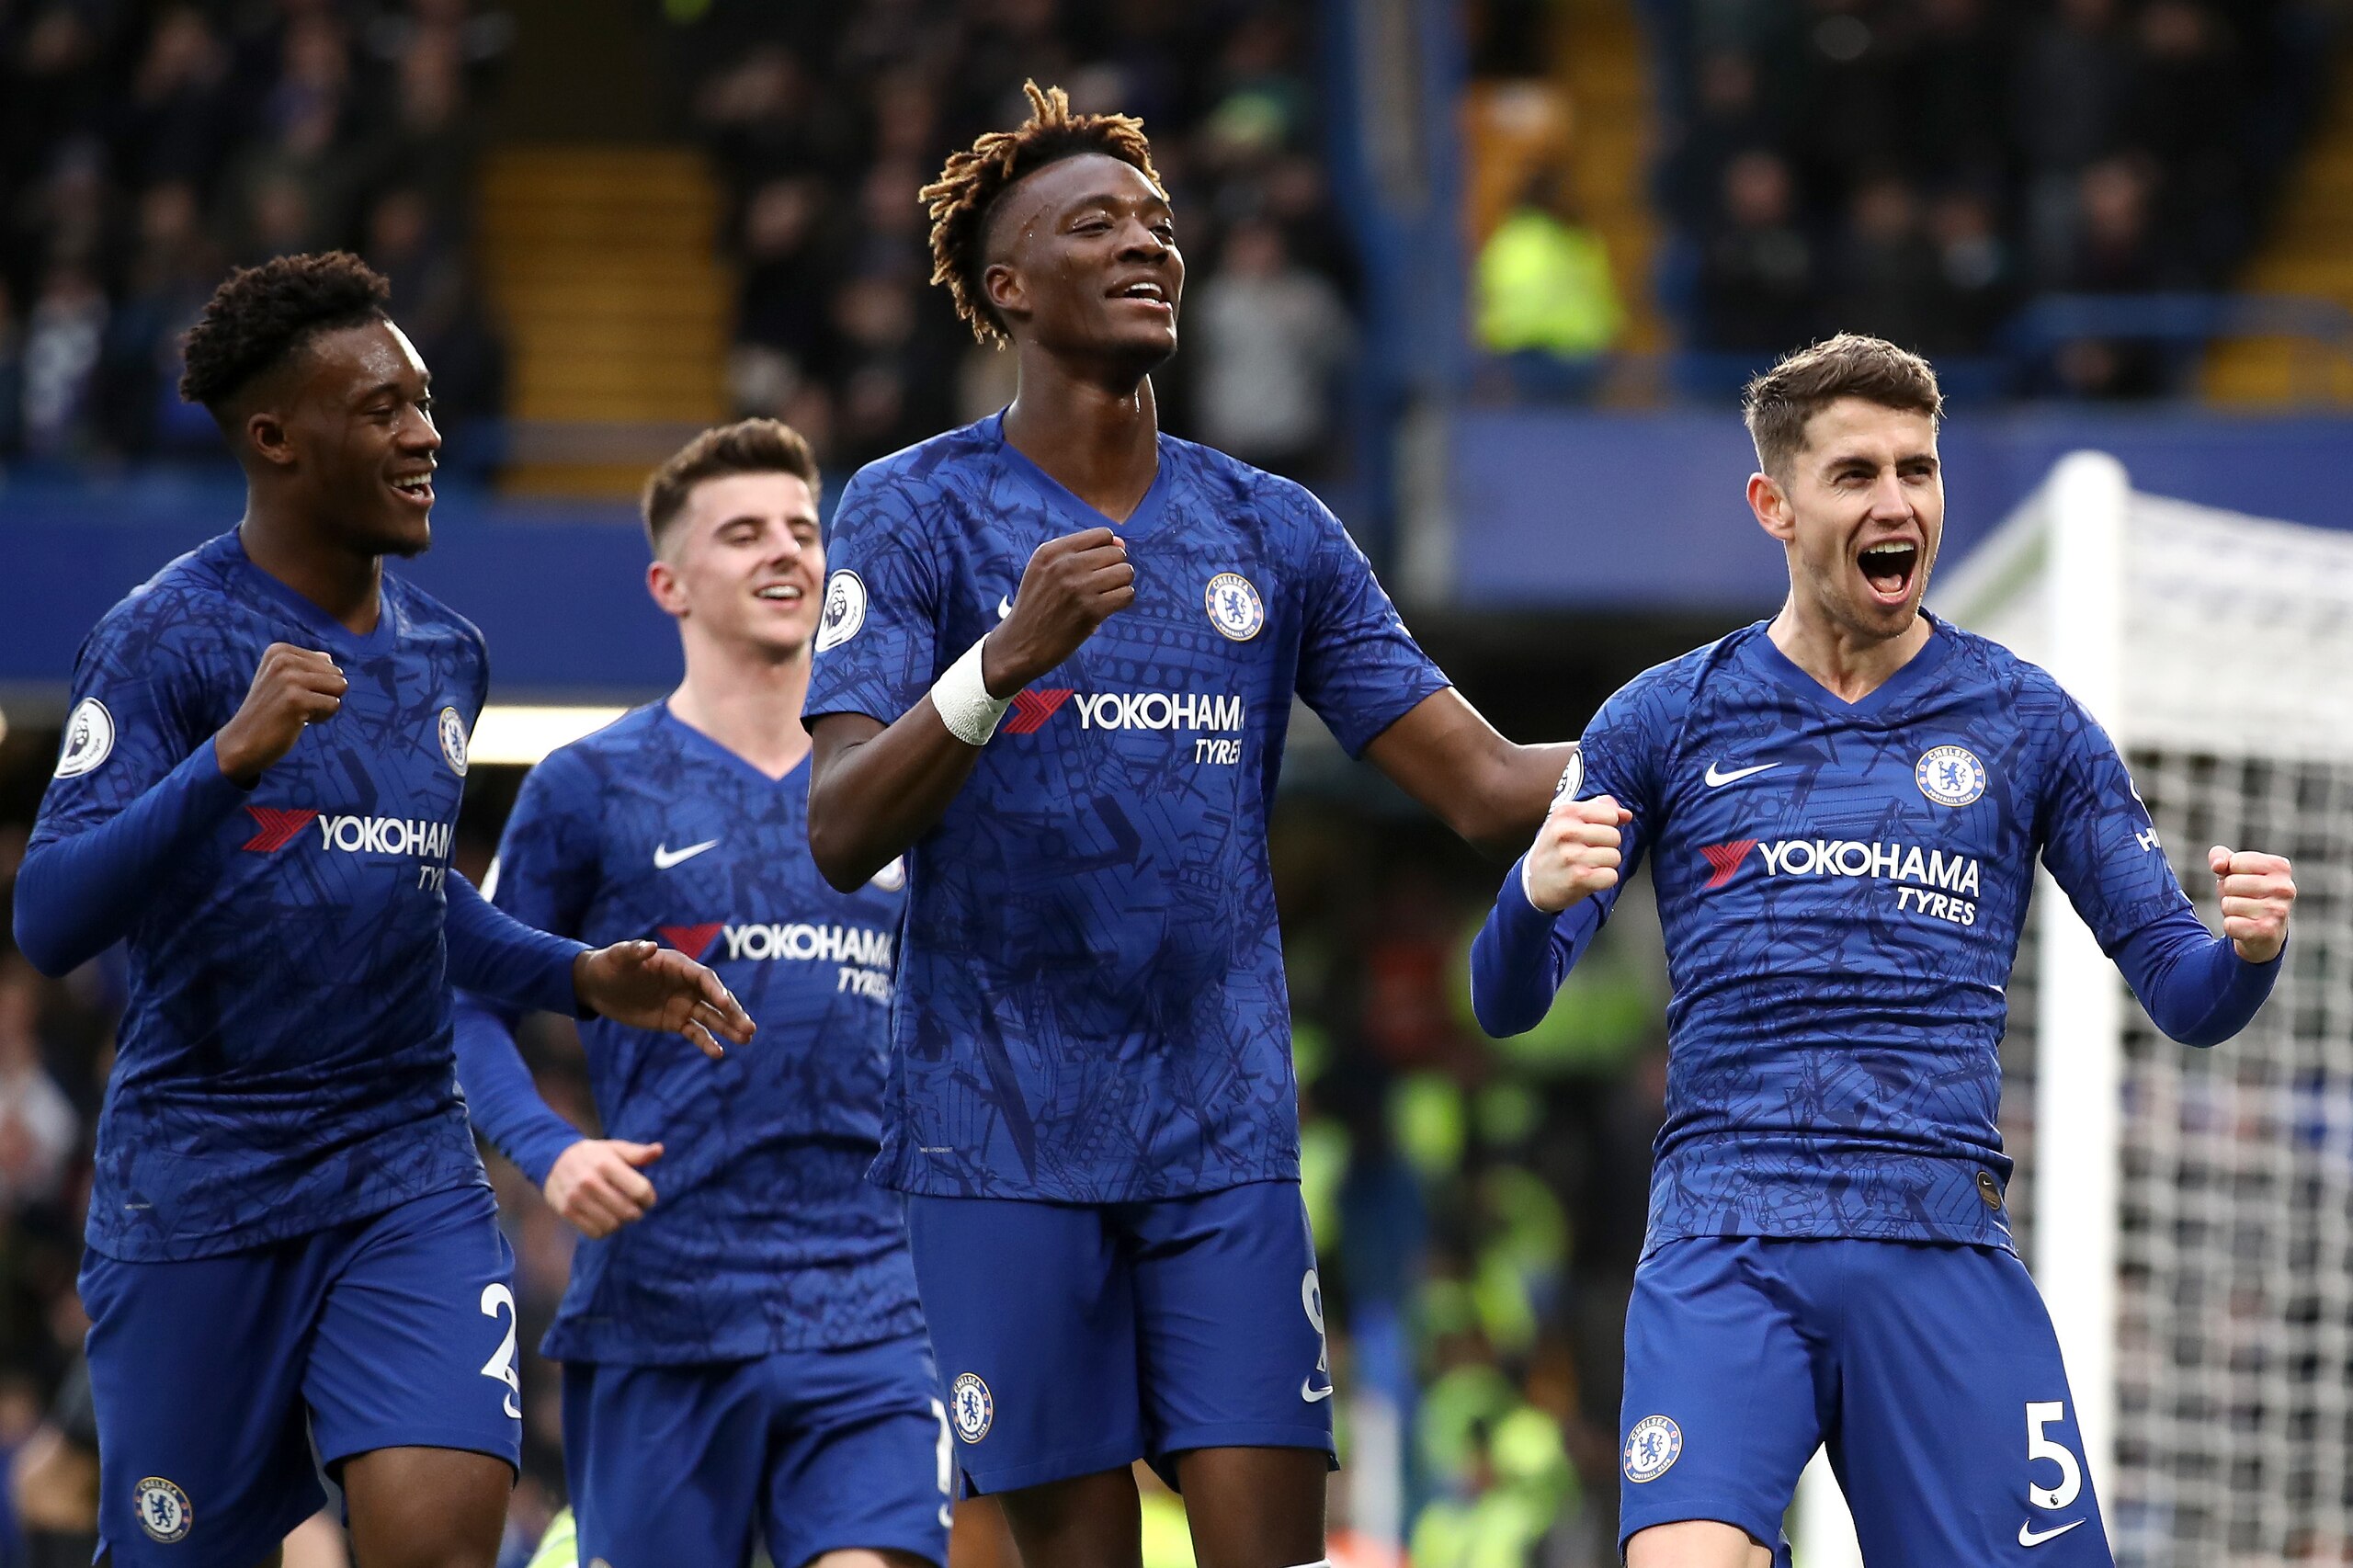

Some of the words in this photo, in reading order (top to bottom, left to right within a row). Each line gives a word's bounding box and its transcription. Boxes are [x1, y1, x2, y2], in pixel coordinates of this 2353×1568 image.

[1212, 575, 1249, 592] CHELSEA
[1927, 748, 1973, 764] CHELSEA
[2135, 827, 2161, 853] H
[1757, 840, 1980, 898] YOKOHAMA
[1896, 886, 1976, 926] TYRES
[480, 1282, 520, 1394] 2
[1631, 1418, 1668, 1441] CHELSEA
[2025, 1401, 2083, 1510] 5
